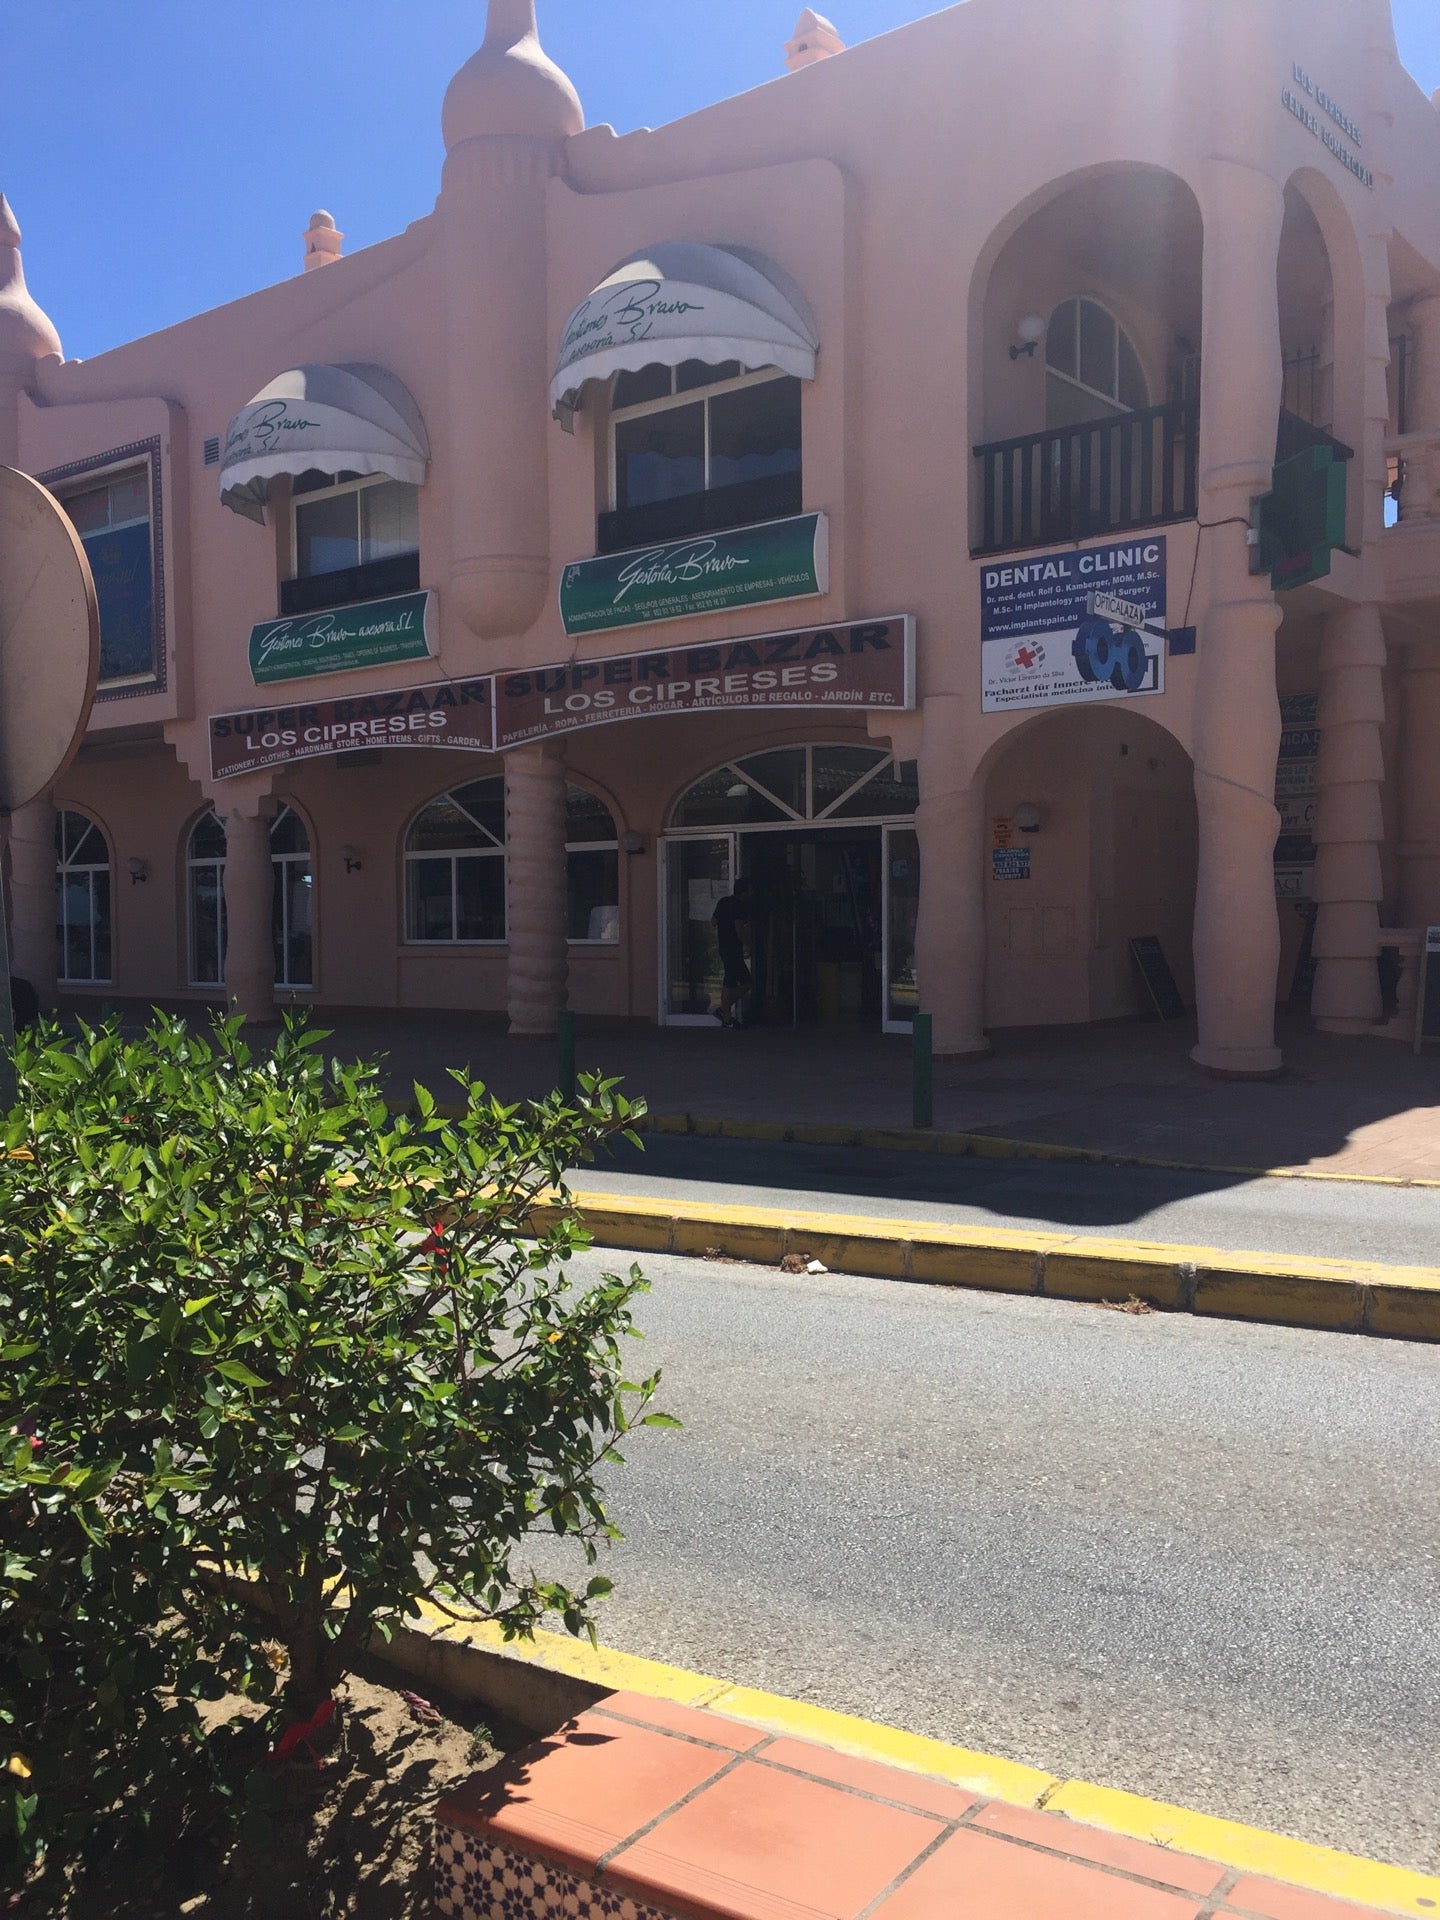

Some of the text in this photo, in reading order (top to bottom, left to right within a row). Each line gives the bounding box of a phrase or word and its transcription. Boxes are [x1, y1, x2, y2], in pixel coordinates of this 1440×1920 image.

[1292, 61, 1362, 148] LOS CIPRESES
[1281, 87, 1373, 191] CENTRO COMERCIAL
[601, 280, 704, 325] Bravo
[247, 401, 320, 438] Bravo
[663, 539, 749, 581] Bravo
[985, 544, 1159, 589] DENTAL CLINIC
[736, 584, 744, 593] DE
[744, 579, 774, 591] EMPRESAS
[986, 571, 1160, 604] Dr. med. dent. Rolf G. Kamberger, MOM, M.Sc.
[993, 605, 1013, 615] M.Sc.
[1015, 603, 1022, 612] in
[1024, 595, 1072, 611] Implantology
[1118, 584, 1151, 597] Surgery
[300, 614, 356, 648] Bravo
[988, 612, 1078, 633] www.implantspain.eu
[504, 624, 892, 698] SUPER BAZAR
[214, 681, 485, 738] SUPER BAZAAR
[544, 662, 838, 715] LOS CIPRESES
[984, 685, 1030, 698] Facharzt
[1034, 682, 1050, 692] für
[1053, 680, 1088, 689] Innere
[995, 690, 1049, 703] Especialista
[1051, 685, 1094, 696] medicina
[246, 711, 447, 750] LOS CIPRESES
[502, 723, 548, 743] PAPELERÍA
[555, 716, 578, 729] ROPA
[650, 700, 684, 712] HOGAR
[692, 692, 749, 708] ARTÍCULOS
[752, 692, 767, 703] DE
[769, 691, 812, 702] REGALO
[821, 689, 864, 701] JARDÍN
[869, 691, 896, 703] ETC.
[217, 759, 256, 777] STATIONERY
[260, 750, 290, 764] CLOTHES
[295, 742, 333, 756] HARDWARE
[337, 738, 360, 749] STORE
[366, 736, 387, 745] HOME
[389, 735, 412, 744] ITEMS
[417, 735, 440, 744] GIFTS
[447, 735, 480, 747] GARDEN
